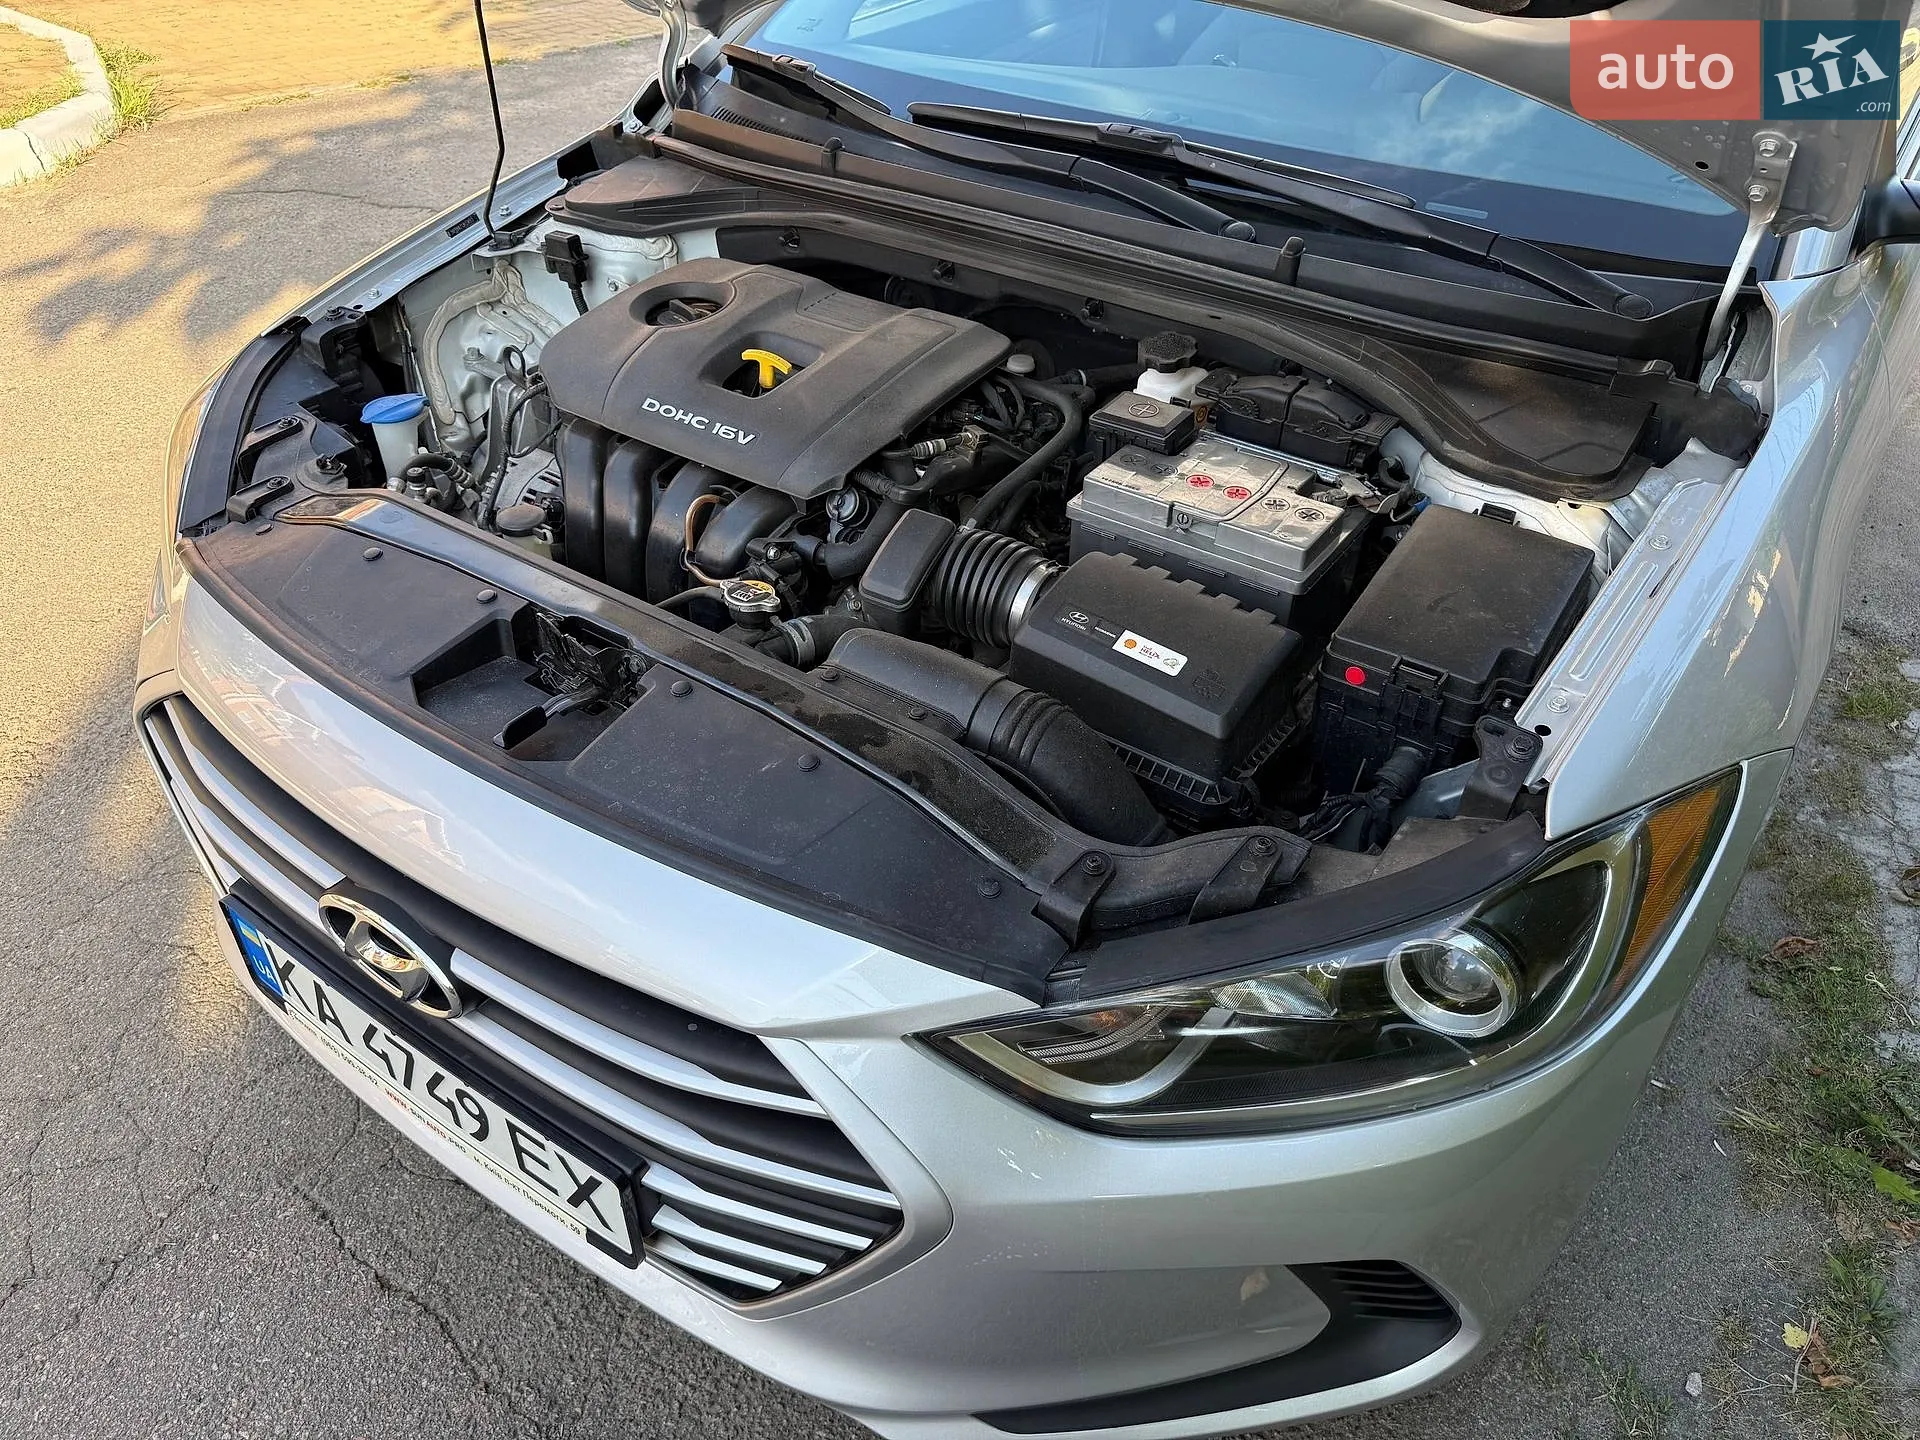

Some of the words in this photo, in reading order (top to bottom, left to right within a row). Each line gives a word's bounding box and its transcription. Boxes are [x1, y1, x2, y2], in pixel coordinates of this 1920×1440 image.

[641, 398, 709, 429] DOHC
[712, 422, 755, 445] 16V
[253, 954, 277, 984] UA
[265, 940, 354, 1047] KA
[362, 1022, 490, 1142] 4749
[505, 1118, 615, 1233] EX
